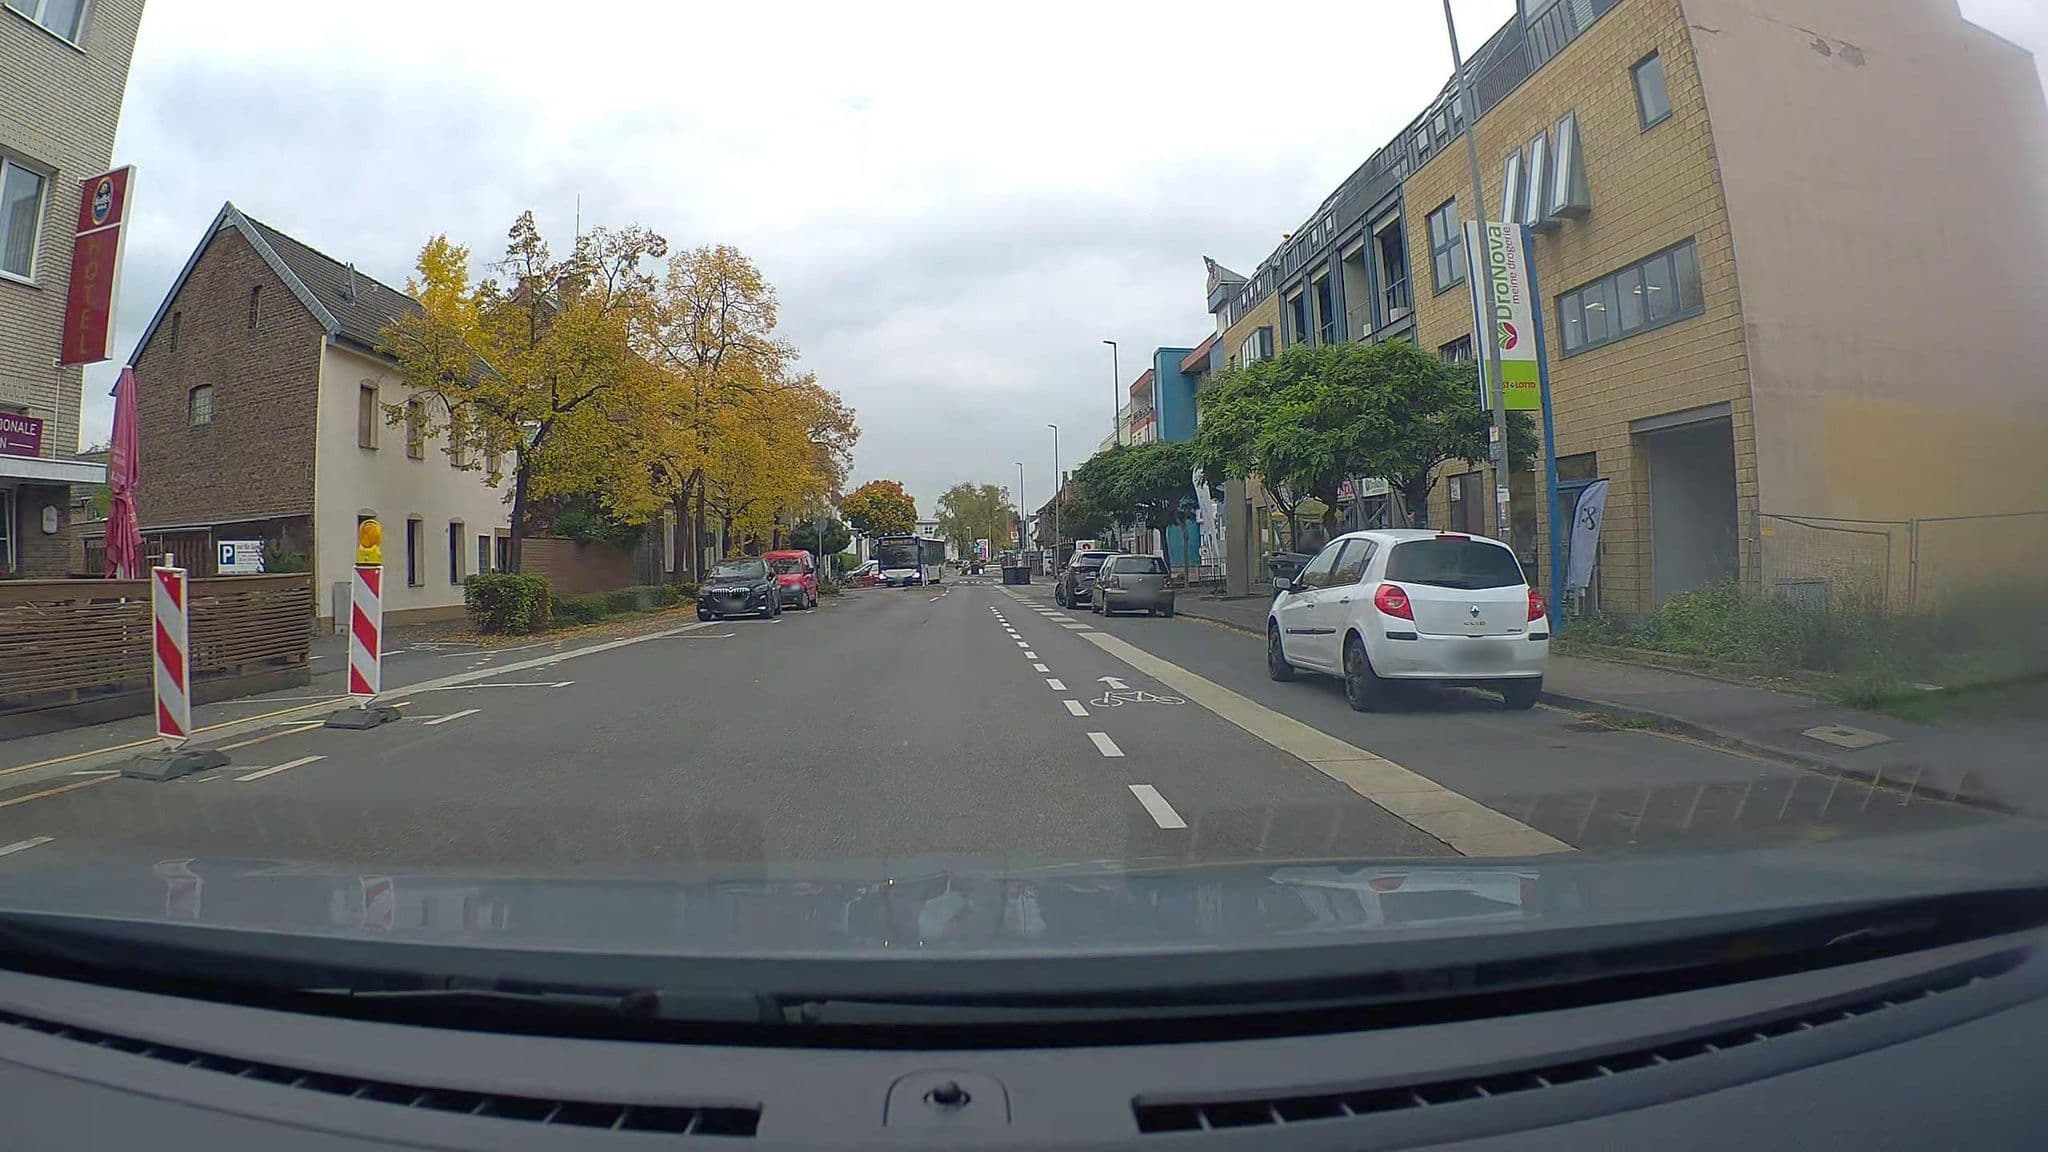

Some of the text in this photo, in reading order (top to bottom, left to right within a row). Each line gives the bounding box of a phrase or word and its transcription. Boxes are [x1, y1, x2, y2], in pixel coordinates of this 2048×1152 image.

[80, 238, 102, 354] HOTEL
[1488, 226, 1513, 320] DroNova
[1504, 226, 1520, 304] meine drogerie
[0, 418, 37, 436] IONALE
[222, 545, 233, 563] P
